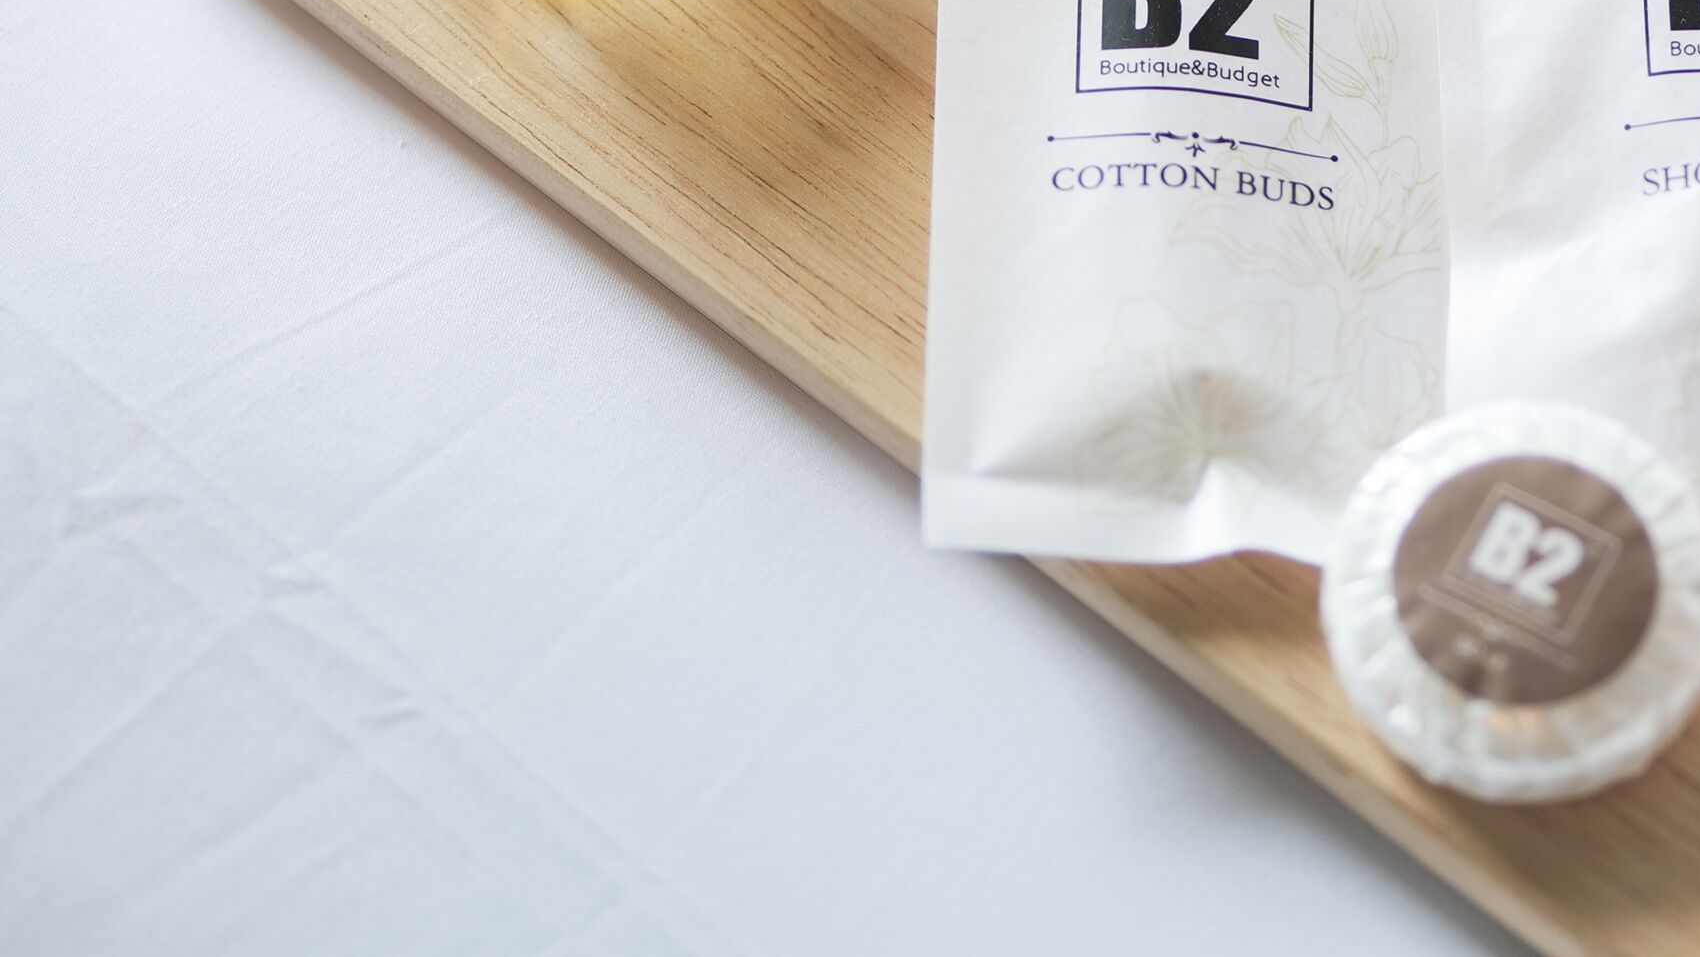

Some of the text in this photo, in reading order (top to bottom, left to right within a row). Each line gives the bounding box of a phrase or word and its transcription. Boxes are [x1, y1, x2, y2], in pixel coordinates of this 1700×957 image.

[1099, 58, 1281, 89] Boutique&Budget
[1051, 162, 1336, 211] COTTON BUDS
[1468, 499, 1585, 608] B2
